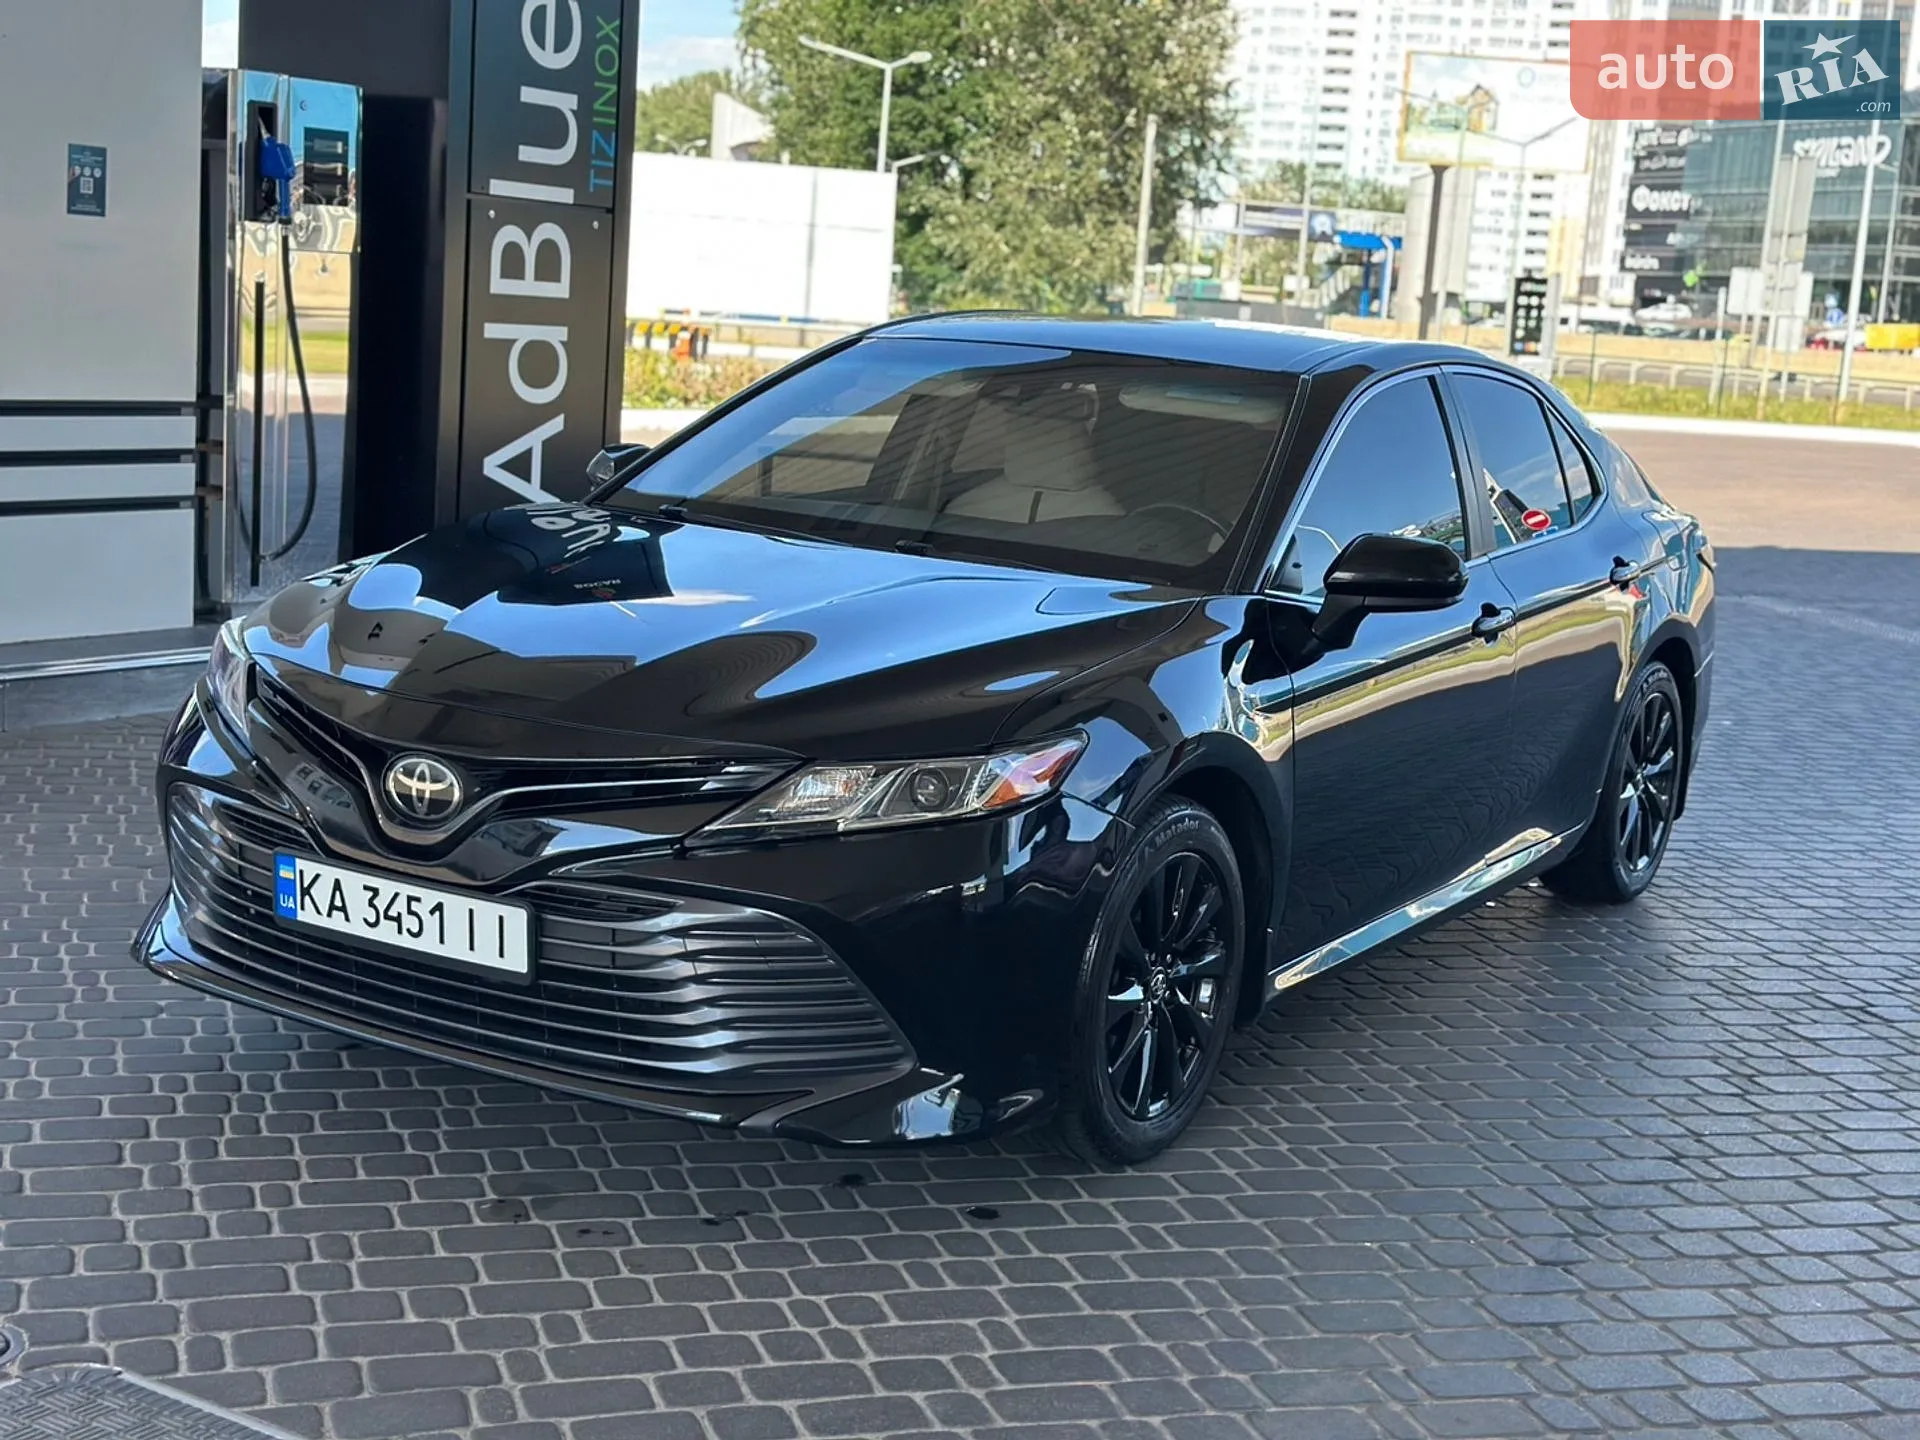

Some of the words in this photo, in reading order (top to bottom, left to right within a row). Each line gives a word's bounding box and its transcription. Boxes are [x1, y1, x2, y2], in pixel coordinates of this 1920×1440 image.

[590, 15, 621, 193] TIZINOX
[483, 0, 583, 503] AdBlue
[279, 893, 296, 909] UA
[299, 868, 351, 923] KA
[362, 883, 446, 945] 3451
